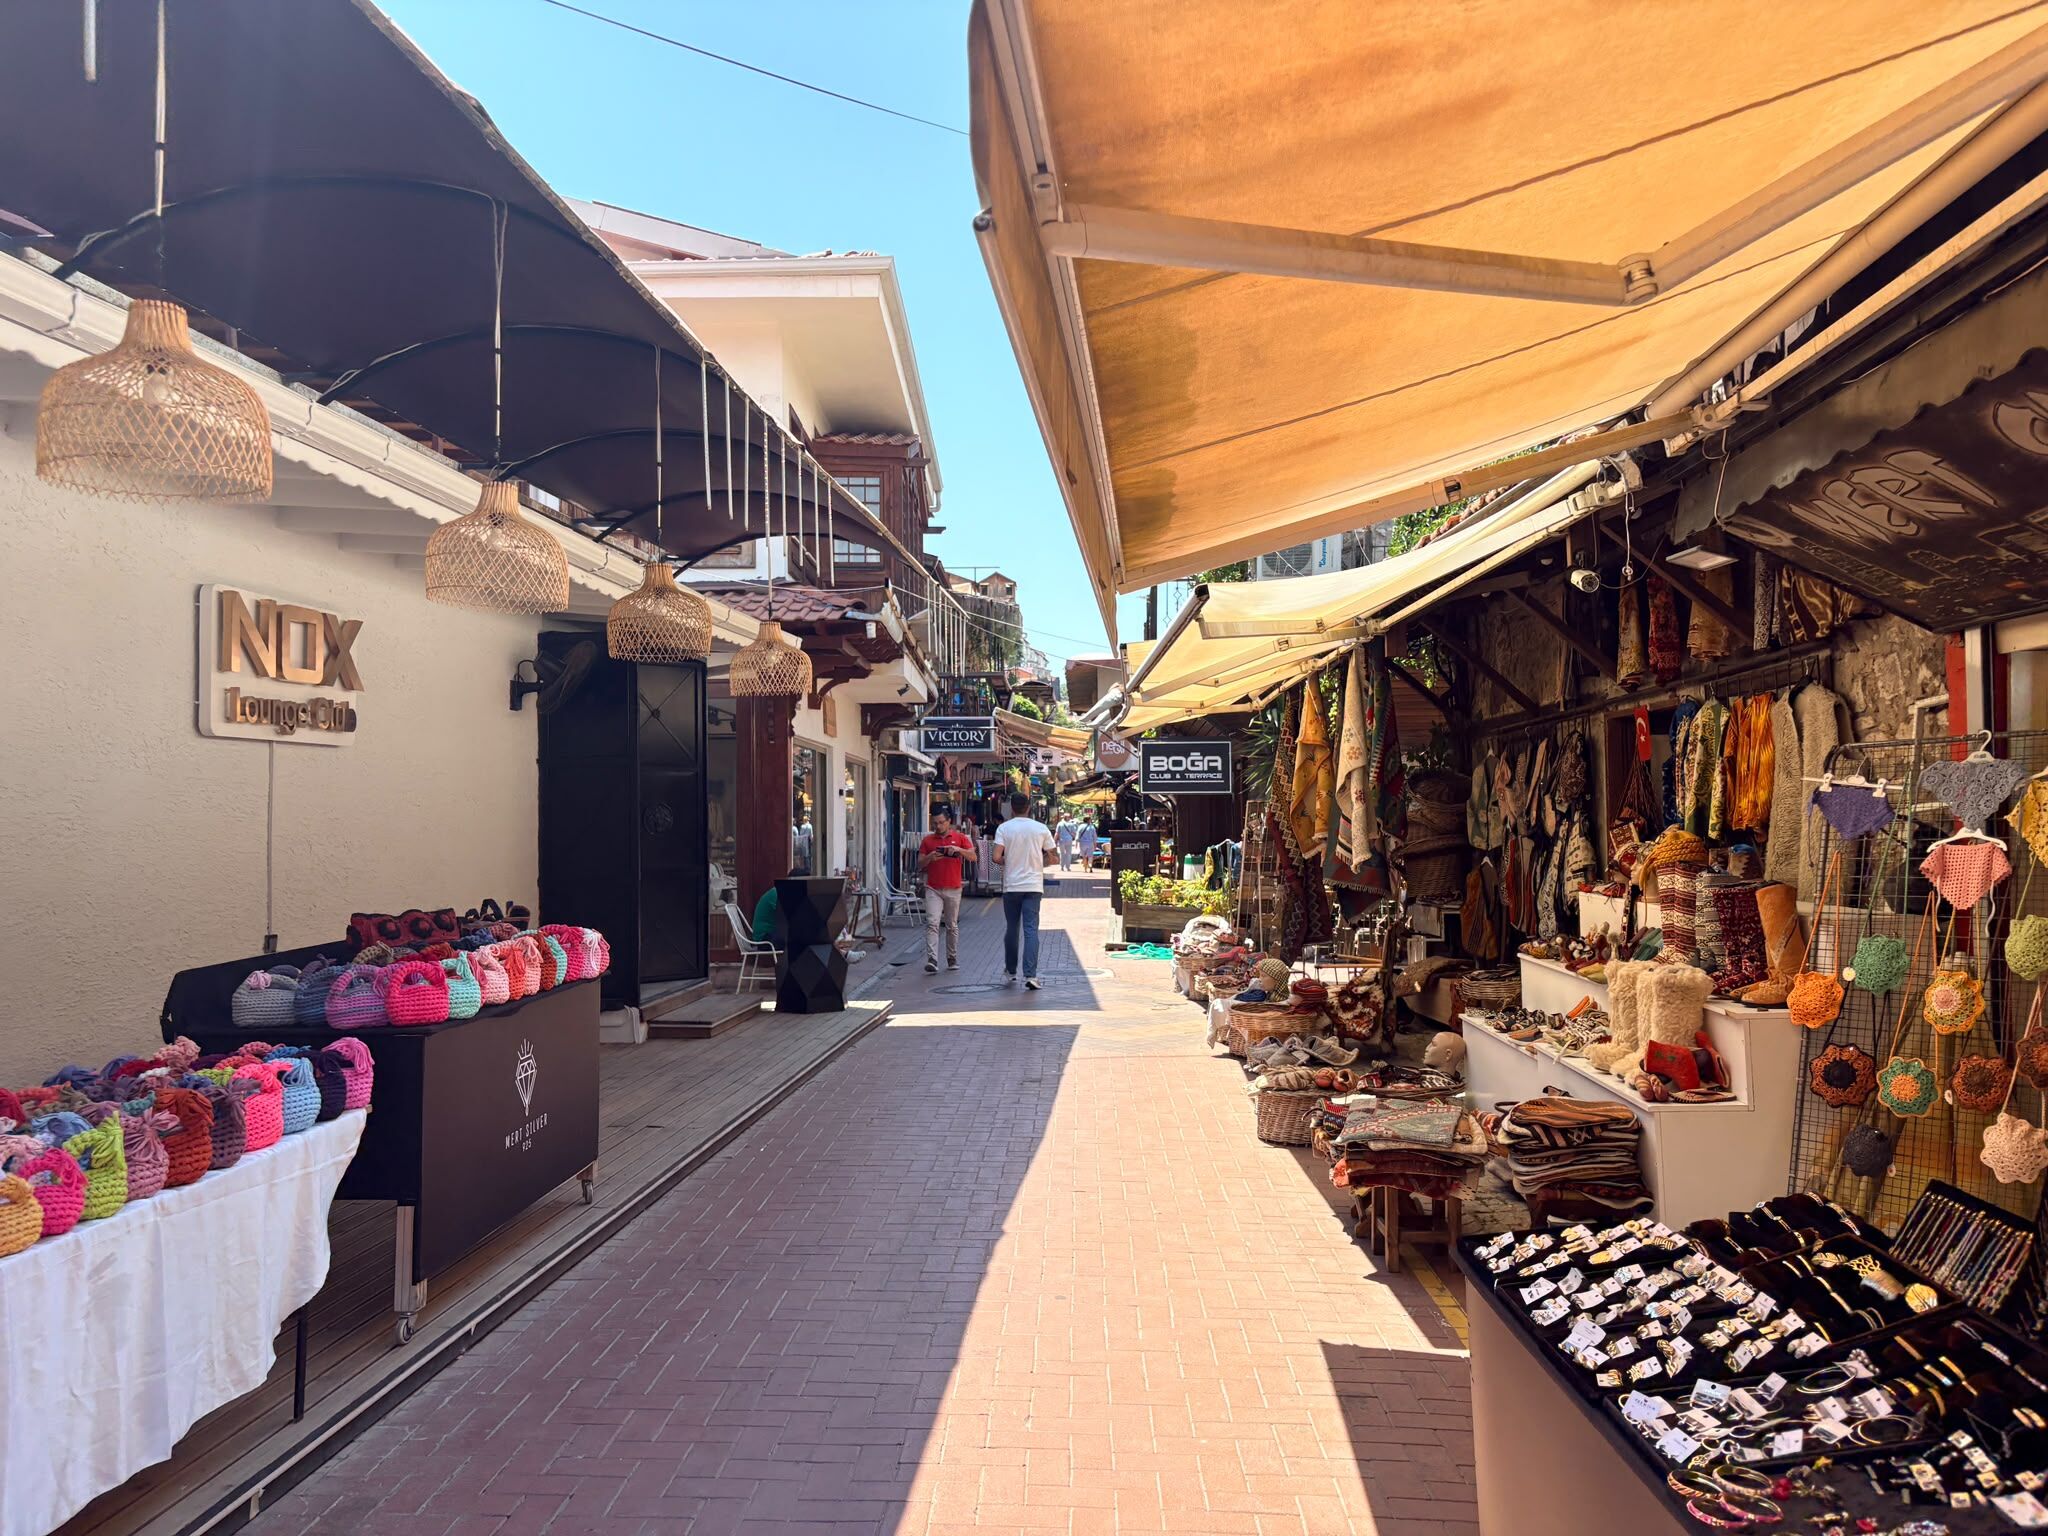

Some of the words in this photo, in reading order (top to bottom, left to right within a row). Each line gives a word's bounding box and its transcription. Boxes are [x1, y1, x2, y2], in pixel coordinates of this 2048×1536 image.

[1786, 448, 1999, 552] MERT
[217, 590, 364, 692] NOX
[225, 687, 309, 736] Lounge
[928, 730, 987, 743] VICTORY
[505, 1127, 522, 1150] MERT
[525, 1113, 548, 1138] SILVER
